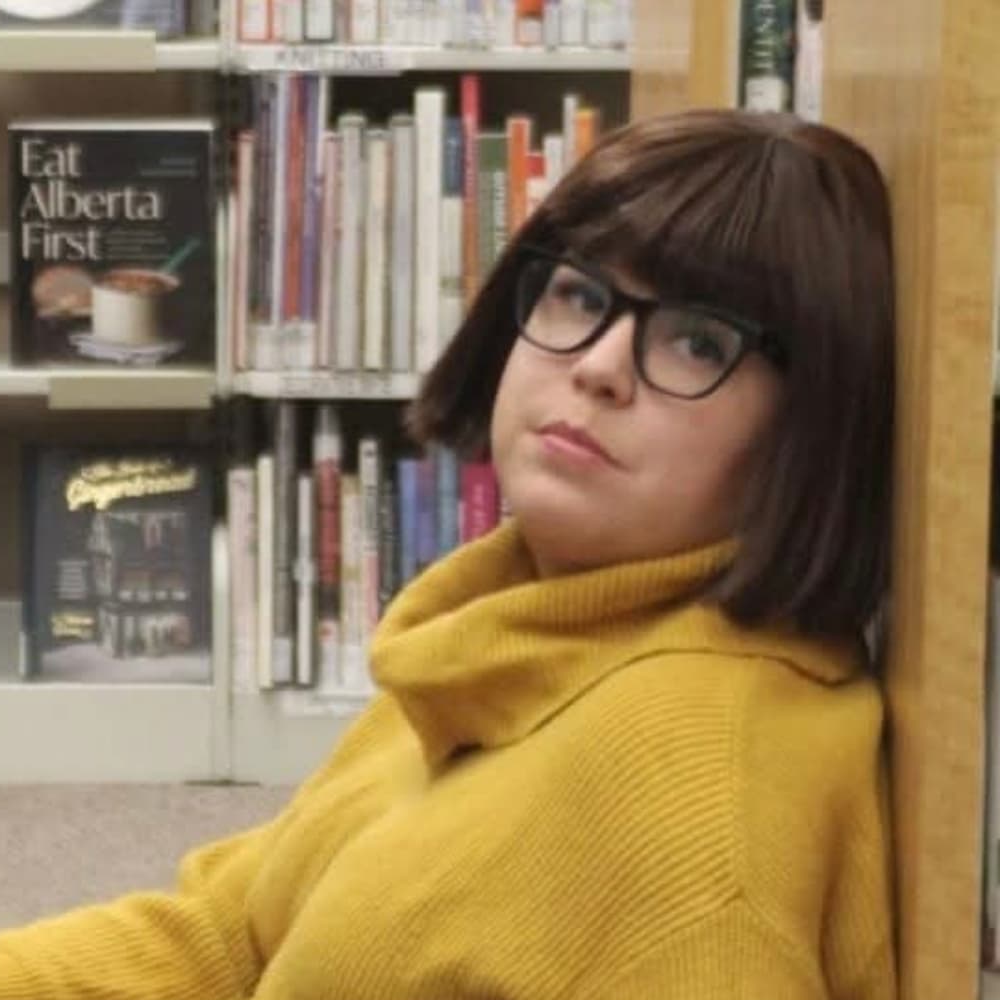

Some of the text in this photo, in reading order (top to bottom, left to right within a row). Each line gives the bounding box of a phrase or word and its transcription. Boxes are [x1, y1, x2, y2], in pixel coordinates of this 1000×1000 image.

[21, 138, 83, 177] Eat
[20, 180, 162, 221] Alberta
[22, 222, 101, 261] First
